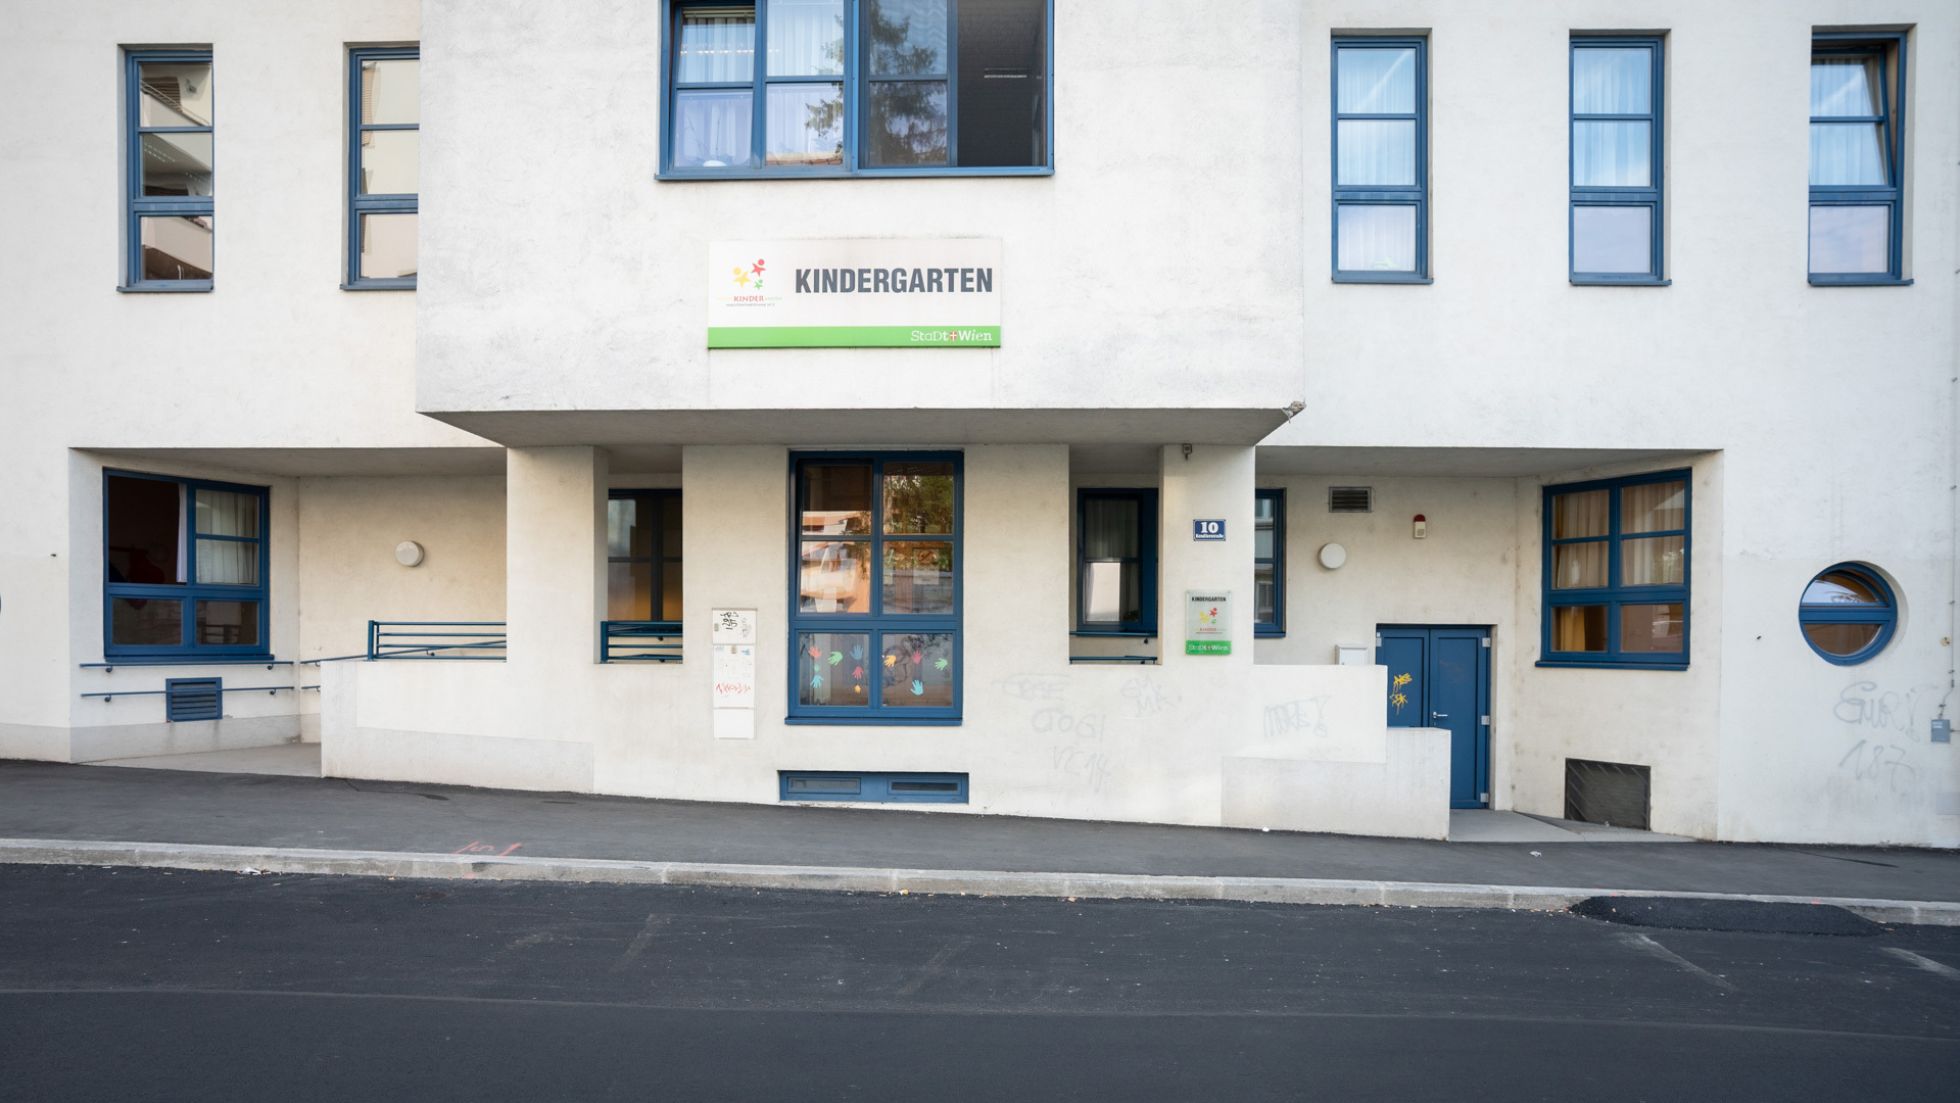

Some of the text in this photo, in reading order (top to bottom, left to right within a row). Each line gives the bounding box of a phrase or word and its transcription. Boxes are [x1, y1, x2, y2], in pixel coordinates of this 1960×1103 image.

[795, 268, 993, 293] KINDERGARTEN
[958, 330, 992, 341] Wien
[1200, 521, 1219, 534] 10
